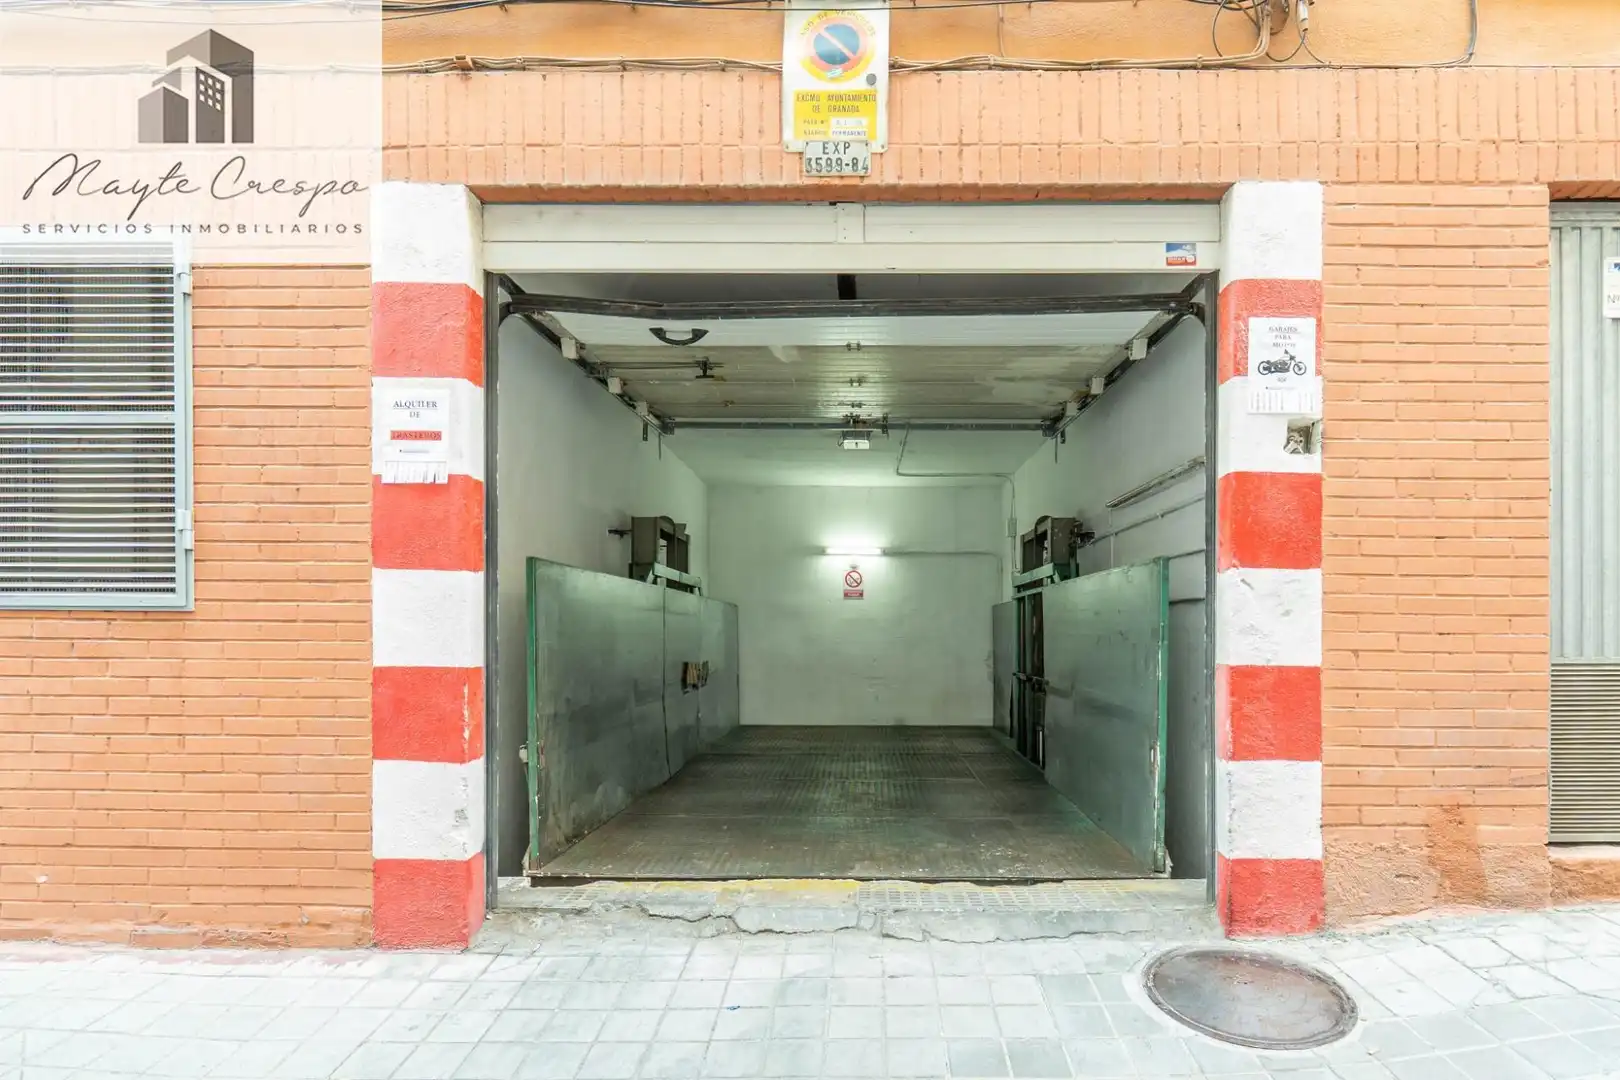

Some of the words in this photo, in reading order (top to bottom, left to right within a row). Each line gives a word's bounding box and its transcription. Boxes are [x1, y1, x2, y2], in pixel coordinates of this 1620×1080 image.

[827, 93, 876, 102] AYUNTAMIENTO
[812, 105, 820, 113] DE
[828, 105, 860, 113] GRANADA
[822, 141, 851, 155] EXP
[805, 156, 869, 174] 3599-84
[393, 400, 438, 409] ALQUILER
